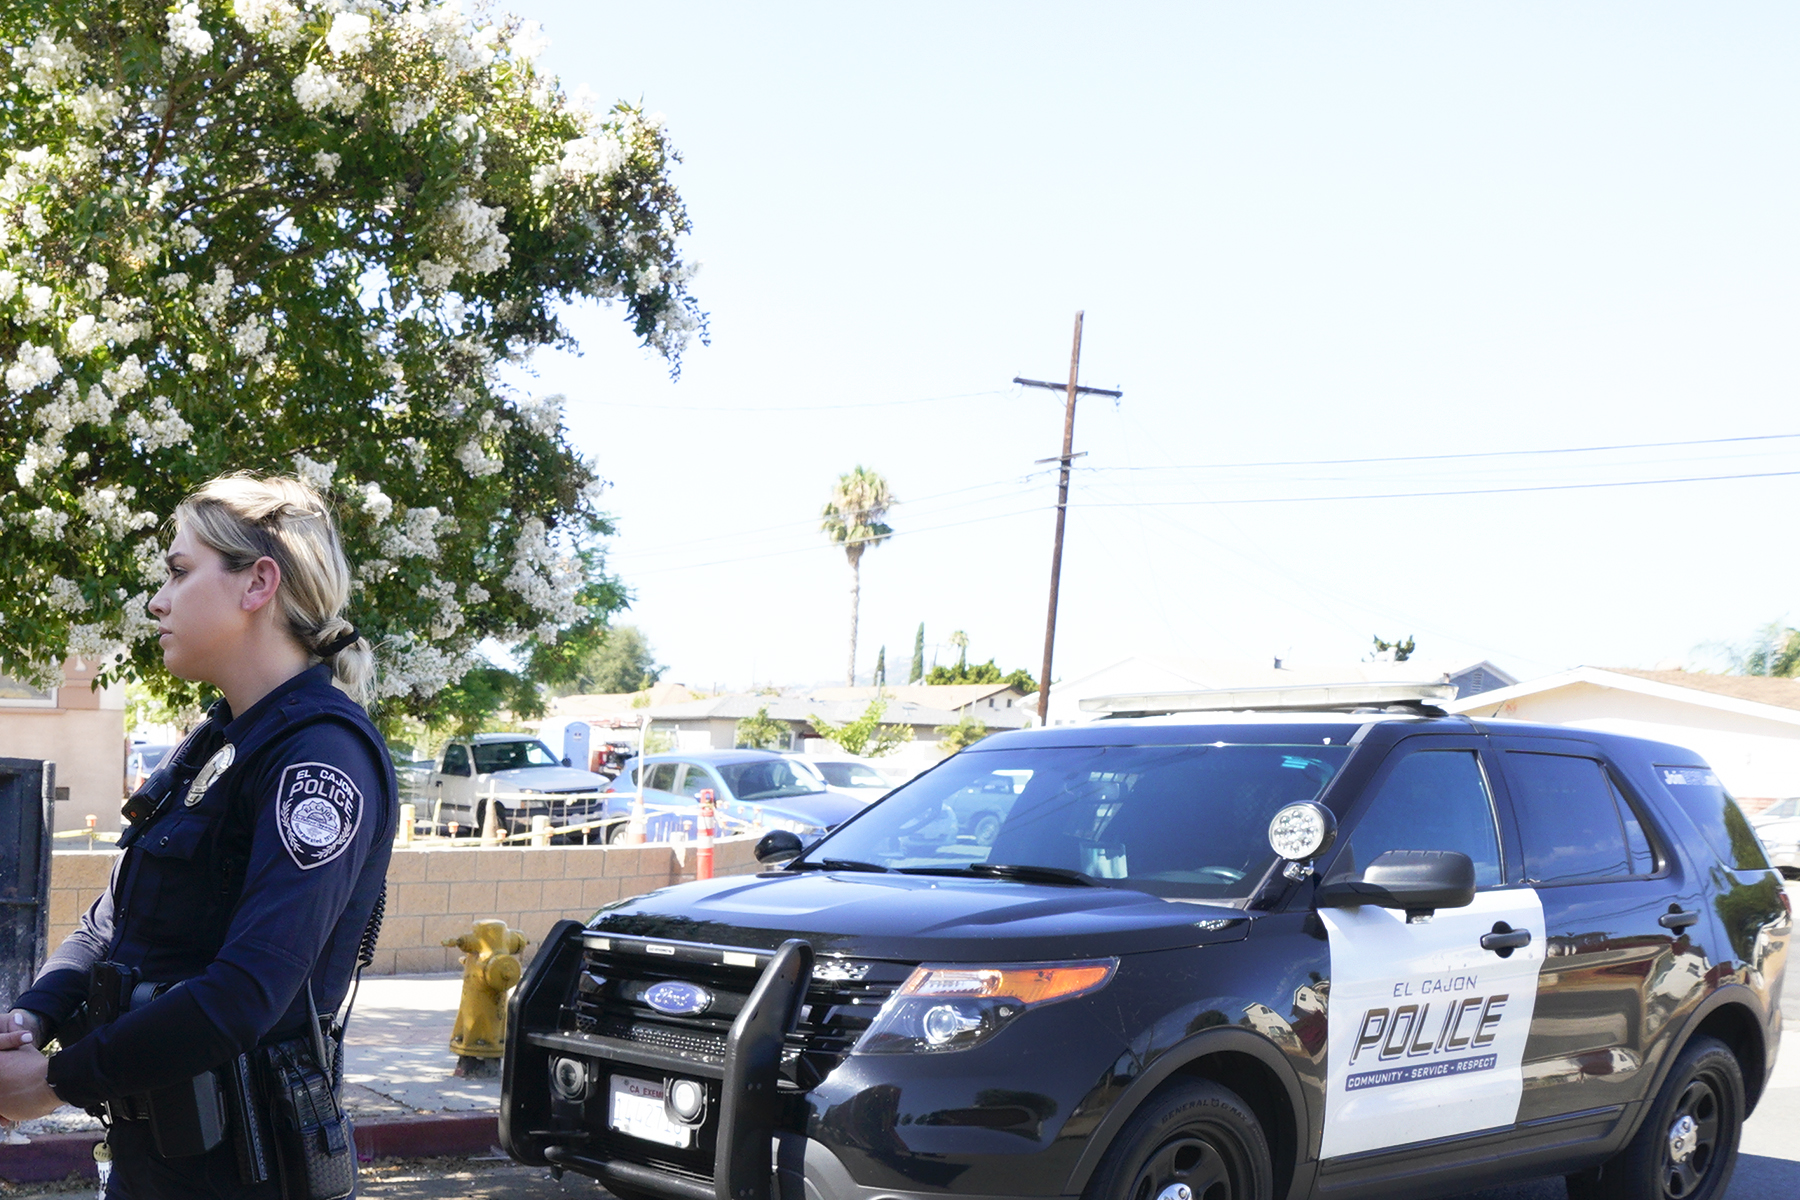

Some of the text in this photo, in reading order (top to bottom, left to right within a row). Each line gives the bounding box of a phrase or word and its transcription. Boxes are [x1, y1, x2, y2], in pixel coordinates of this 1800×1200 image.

[288, 779, 354, 819] POLICE
[296, 769, 354, 801] EL CAJON
[1393, 975, 1478, 998] EL CAJON
[1348, 993, 1510, 1066] POLICE
[1347, 1057, 1495, 1088] COMMUNITY SERVICE RESPECT
[629, 1085, 664, 1099] CA EXEM
[1161, 1099, 1209, 1124] GENERAL
